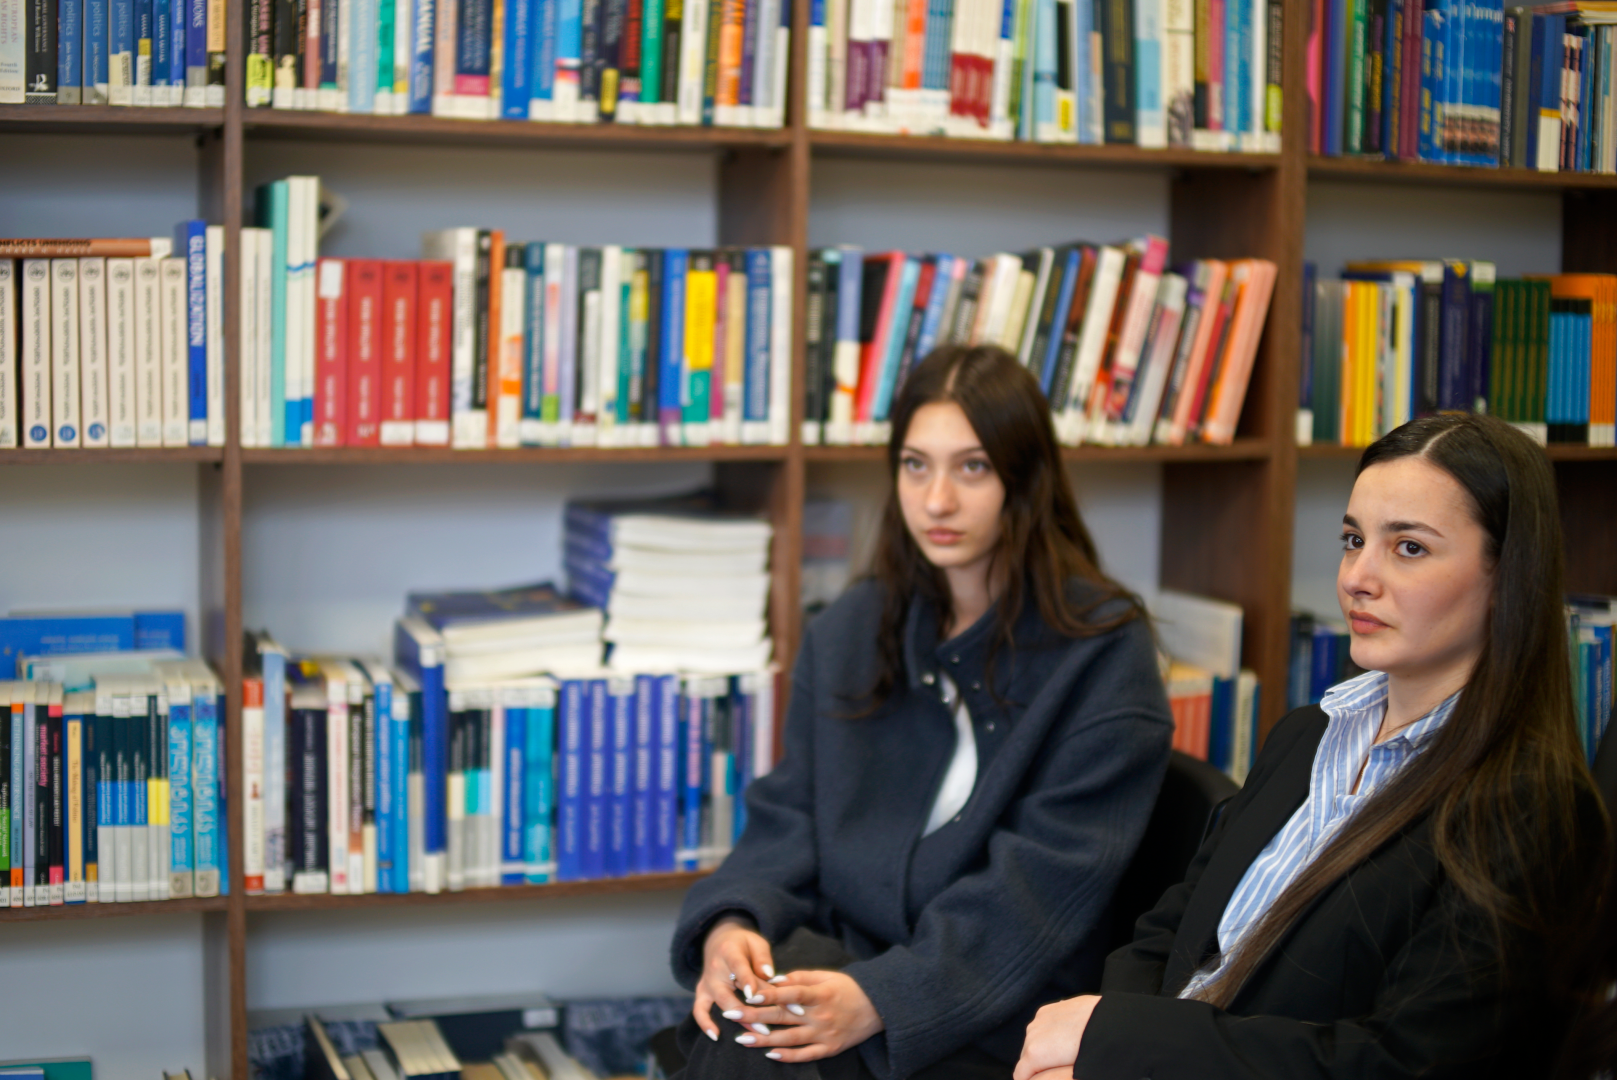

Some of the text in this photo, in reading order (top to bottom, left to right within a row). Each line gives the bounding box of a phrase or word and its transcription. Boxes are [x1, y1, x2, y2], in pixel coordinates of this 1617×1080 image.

[64, 0, 77, 37] politics
[91, 1, 104, 37] politics
[116, 2, 130, 38] politics
[415, 0, 434, 55] ANUAL
[0, 239, 38, 247] NFLICTS
[189, 235, 205, 347] GLOBALIZATION
[13, 716, 21, 821] RETHINKING GOVERNANCE
[37, 724, 49, 788] market society
[169, 725, 189, 834] პოლიტიკა
[194, 724, 214, 834] პოლიტიკა
